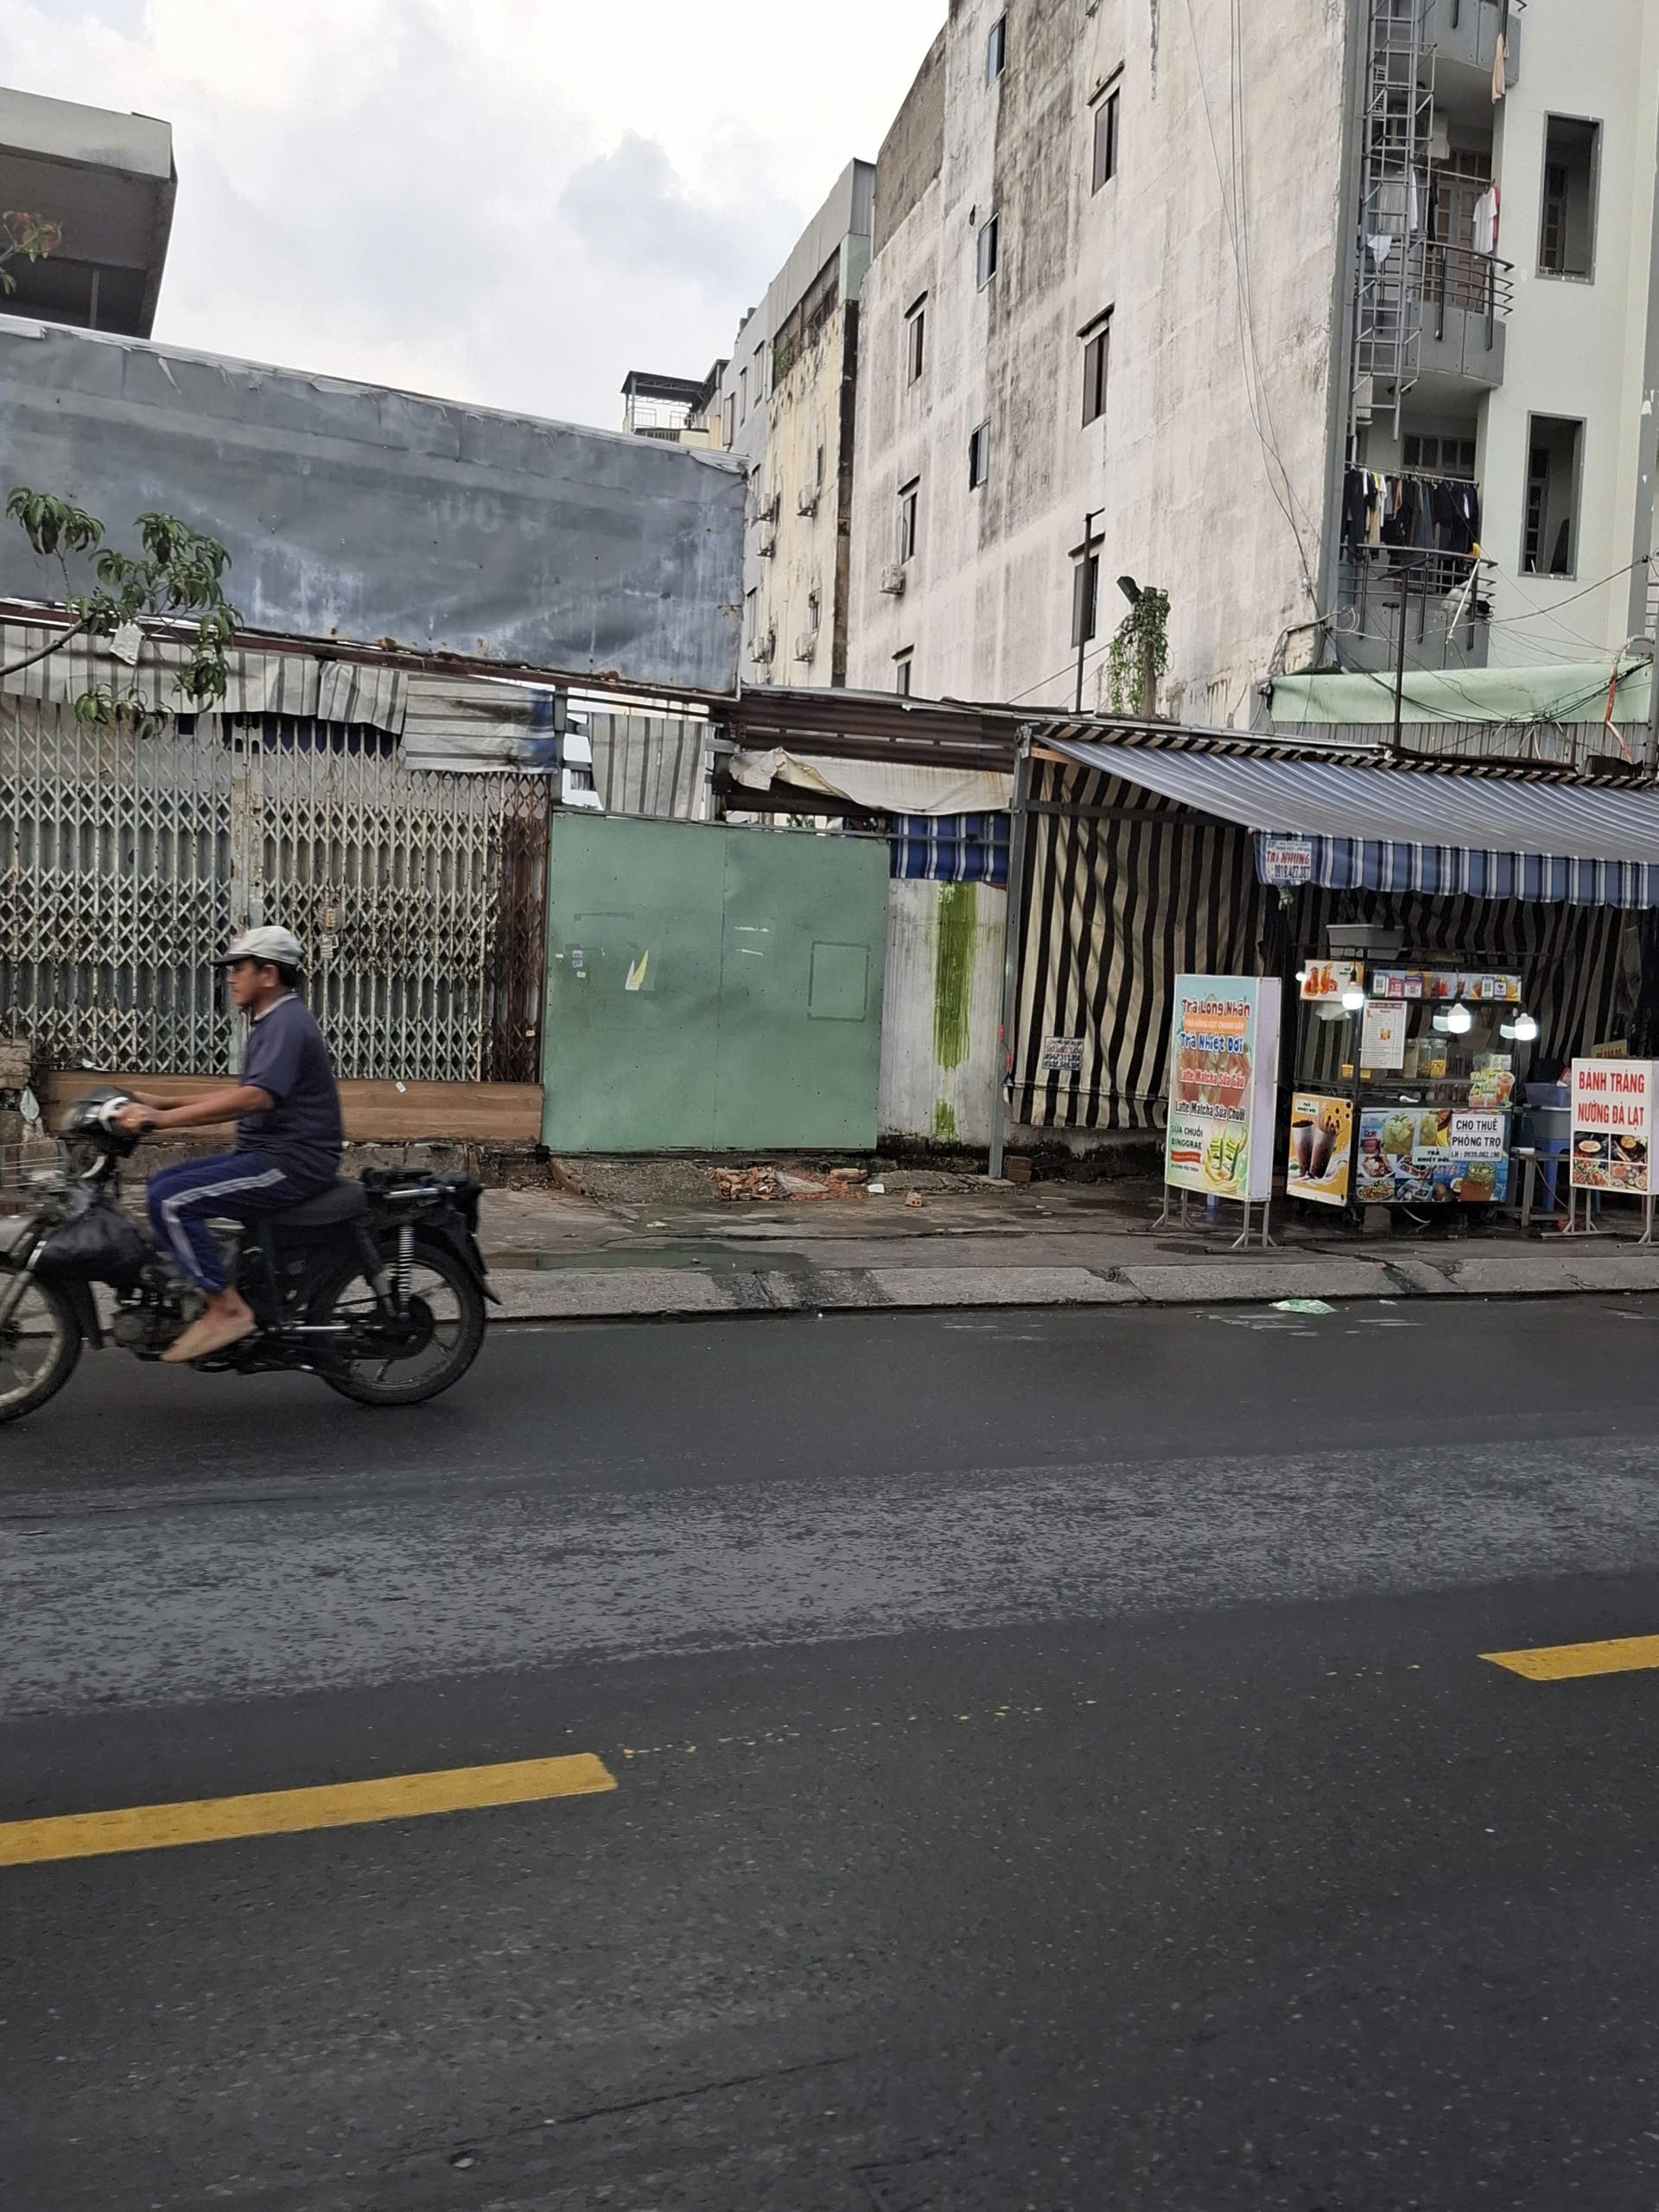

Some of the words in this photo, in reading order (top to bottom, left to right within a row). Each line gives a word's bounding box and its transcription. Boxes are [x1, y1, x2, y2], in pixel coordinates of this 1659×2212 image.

[1201, 1000, 1224, 1016] Long
[1179, 1068, 1193, 1082] Latte
[1195, 1070, 1217, 1084] Matcha
[1579, 1067, 1607, 1091] BÁNH
[1610, 1069, 1645, 1094] TRÁNG
[1175, 1099, 1190, 1113] Latte
[1191, 1102, 1213, 1116] Matcha
[1215, 1105, 1227, 1118] Sữa
[1578, 1099, 1610, 1124] NƯỚNG
[1611, 1101, 1625, 1125] ĐÀ
[1628, 1106, 1644, 1131] LẠT
[1171, 1123, 1183, 1134] SỮA
[1185, 1125, 1203, 1137] CHUỐI
[1456, 1120, 1474, 1130] CHO
[1476, 1117, 1498, 1131] THUÊ
[1171, 1138, 1202, 1150] BINGGRAE
[1452, 1134, 1482, 1147] PHÒNG
[1484, 1136, 1501, 1148] TRỌ
